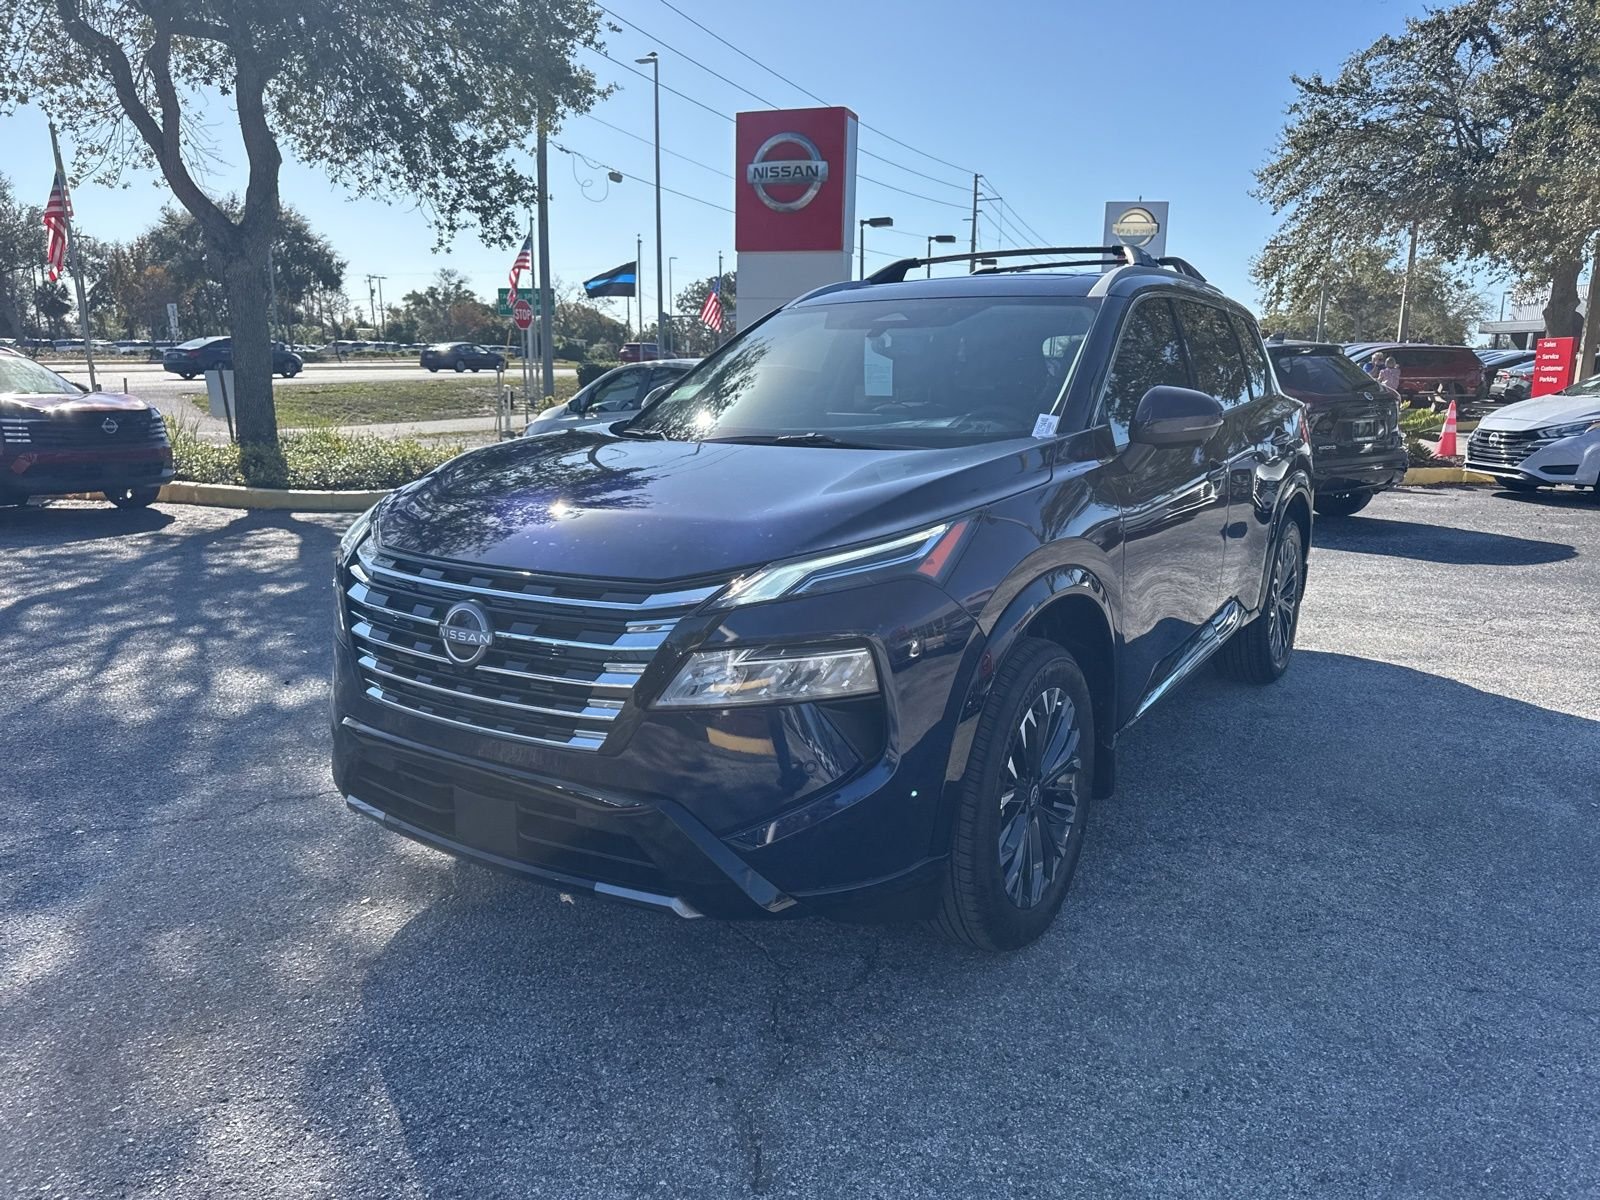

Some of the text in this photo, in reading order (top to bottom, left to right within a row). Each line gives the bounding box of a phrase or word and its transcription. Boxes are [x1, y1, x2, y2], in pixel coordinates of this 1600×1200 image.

[753, 165, 819, 179] NISSAN
[515, 309, 531, 320] STOP
[440, 626, 490, 644] NISSAN
